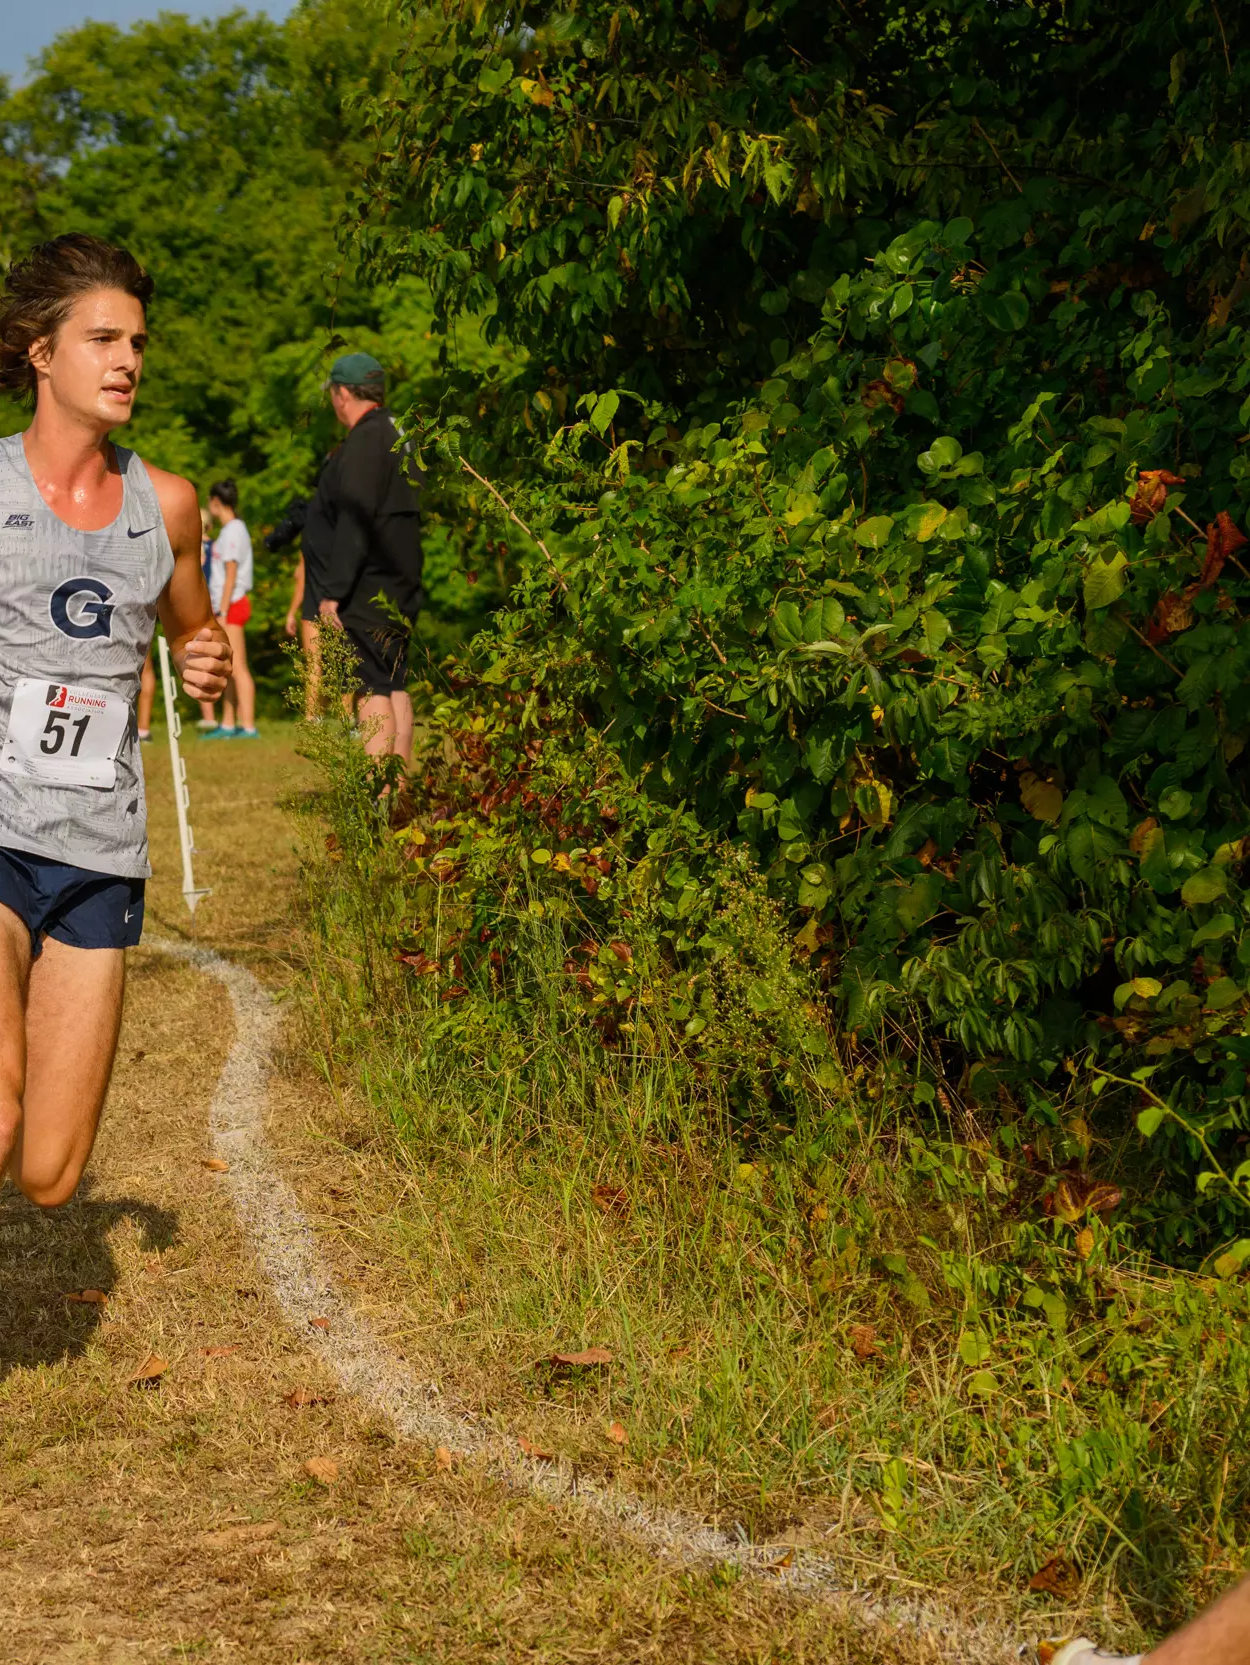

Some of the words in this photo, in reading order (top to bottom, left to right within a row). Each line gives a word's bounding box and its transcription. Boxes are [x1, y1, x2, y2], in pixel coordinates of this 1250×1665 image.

[50, 576, 116, 641] G
[68, 695, 106, 707] RUNNING
[39, 710, 91, 757] 51
